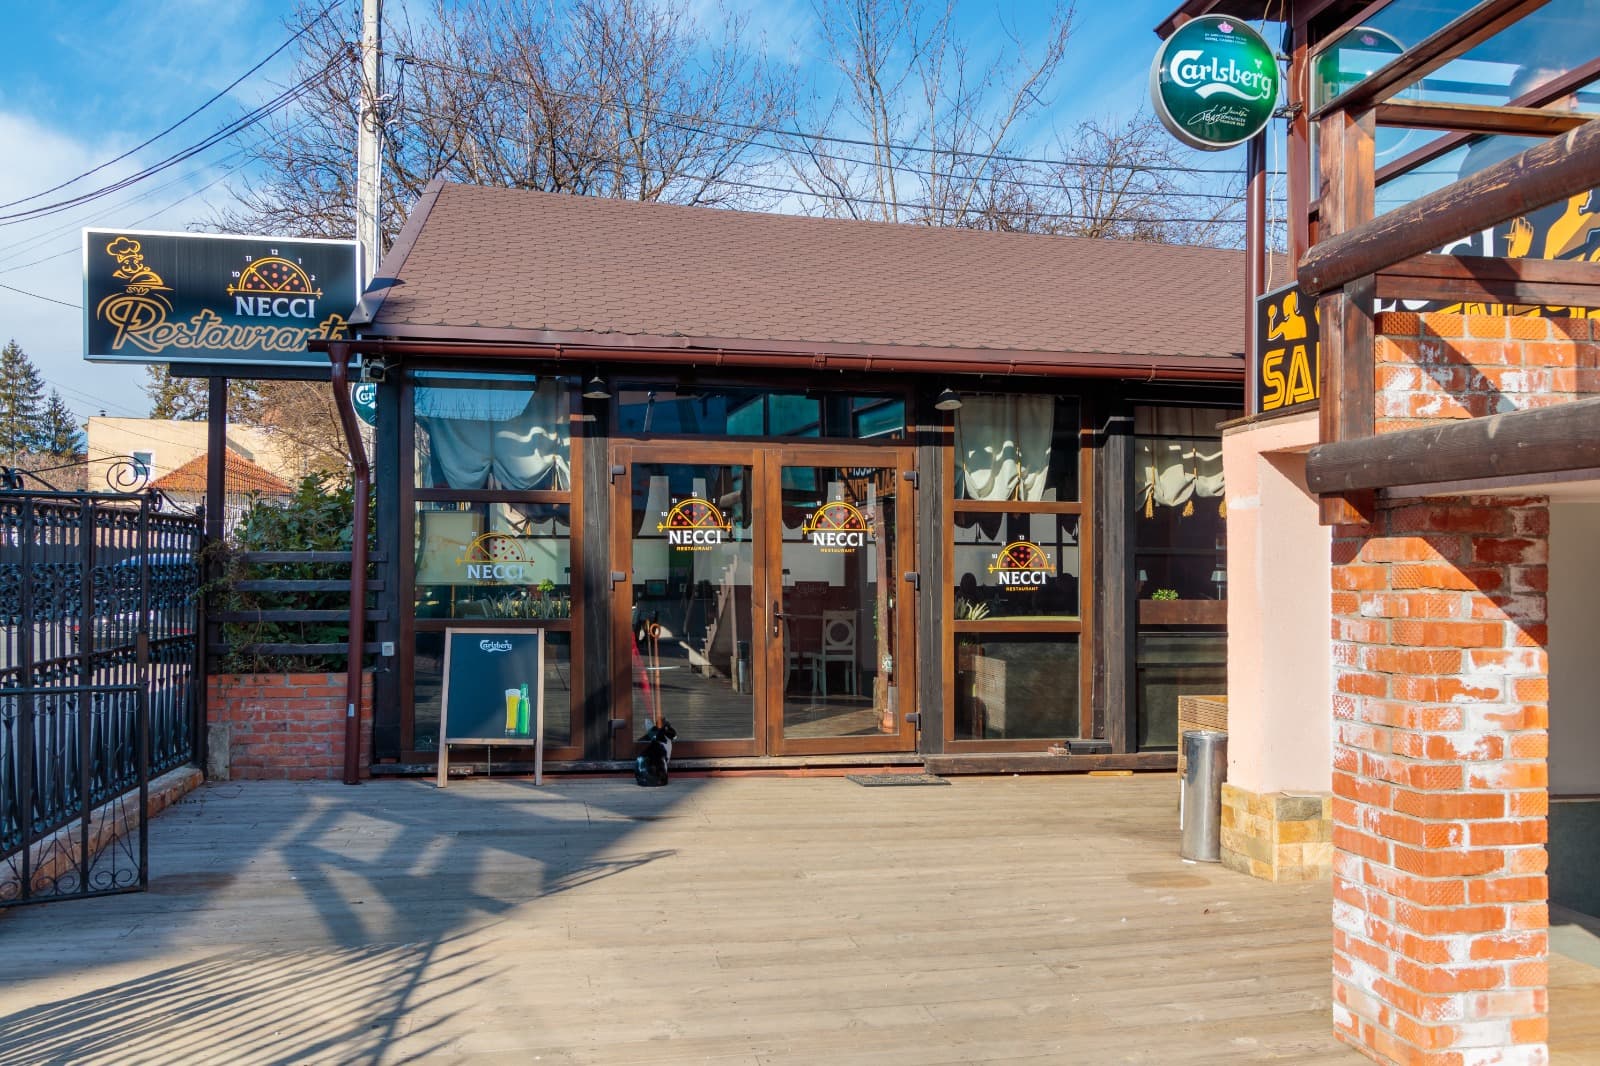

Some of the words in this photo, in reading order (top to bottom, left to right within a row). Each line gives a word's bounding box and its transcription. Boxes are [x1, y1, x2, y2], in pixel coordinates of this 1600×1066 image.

[1170, 50, 1272, 100] Carlsberg
[235, 296, 316, 318] NECCI
[1263, 342, 1320, 411] SA
[668, 530, 722, 544] NECCI
[812, 533, 864, 546] NECCI
[467, 564, 524, 579] NECCI
[998, 571, 1047, 585] NECCI
[480, 640, 512, 652] Carlsberg
